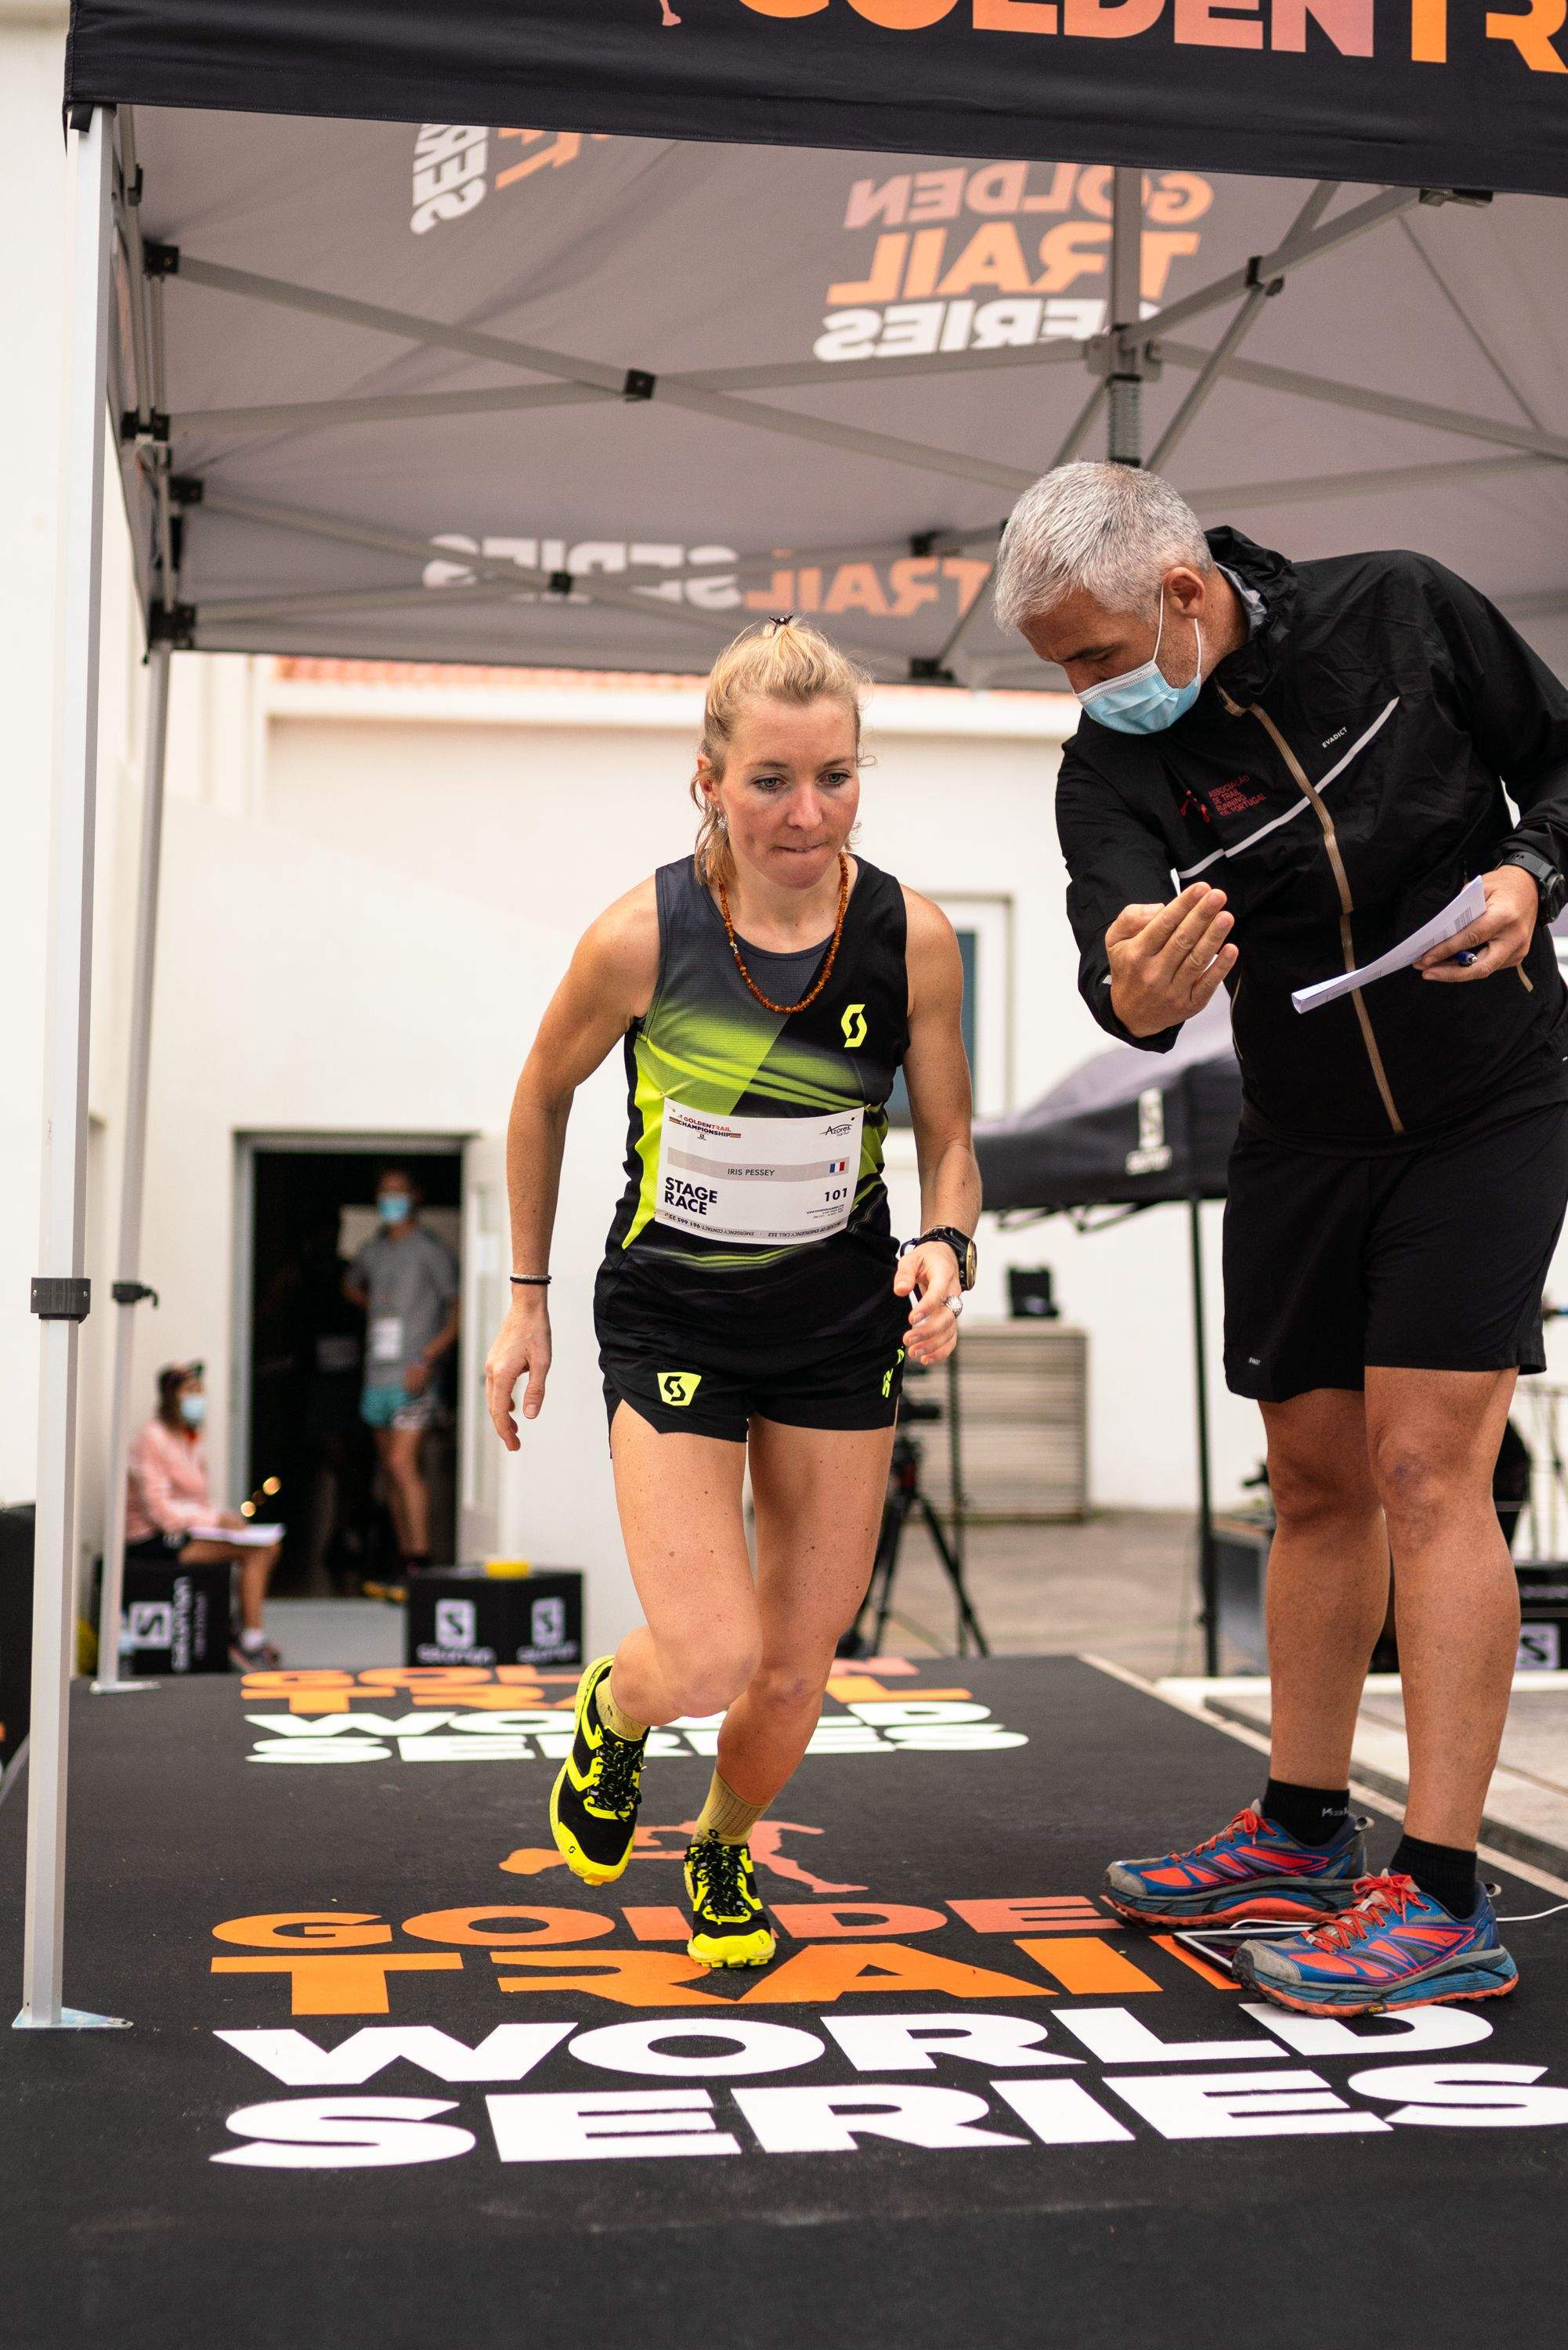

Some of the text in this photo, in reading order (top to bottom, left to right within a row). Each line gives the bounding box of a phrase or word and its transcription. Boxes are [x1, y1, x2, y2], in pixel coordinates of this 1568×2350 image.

[1322, 726, 1348, 748] EVADICT
[1231, 793, 1267, 812] PORTUGAL
[678, 1121, 730, 1137] CHAMPIONSHIP
[727, 1168, 775, 1177] IRIS PESSEY
[665, 1177, 718, 1204] STAGE
[825, 1188, 847, 1202] 101
[664, 1190, 708, 1216] RACE
[791, 1228, 820, 1237] EMERGENCY
[244, 1700, 992, 1737] WOD
[211, 1896, 1125, 1949] GOLDE
[212, 2002, 1494, 2087] WORLD
[208, 2063, 1568, 2169] SERIES
